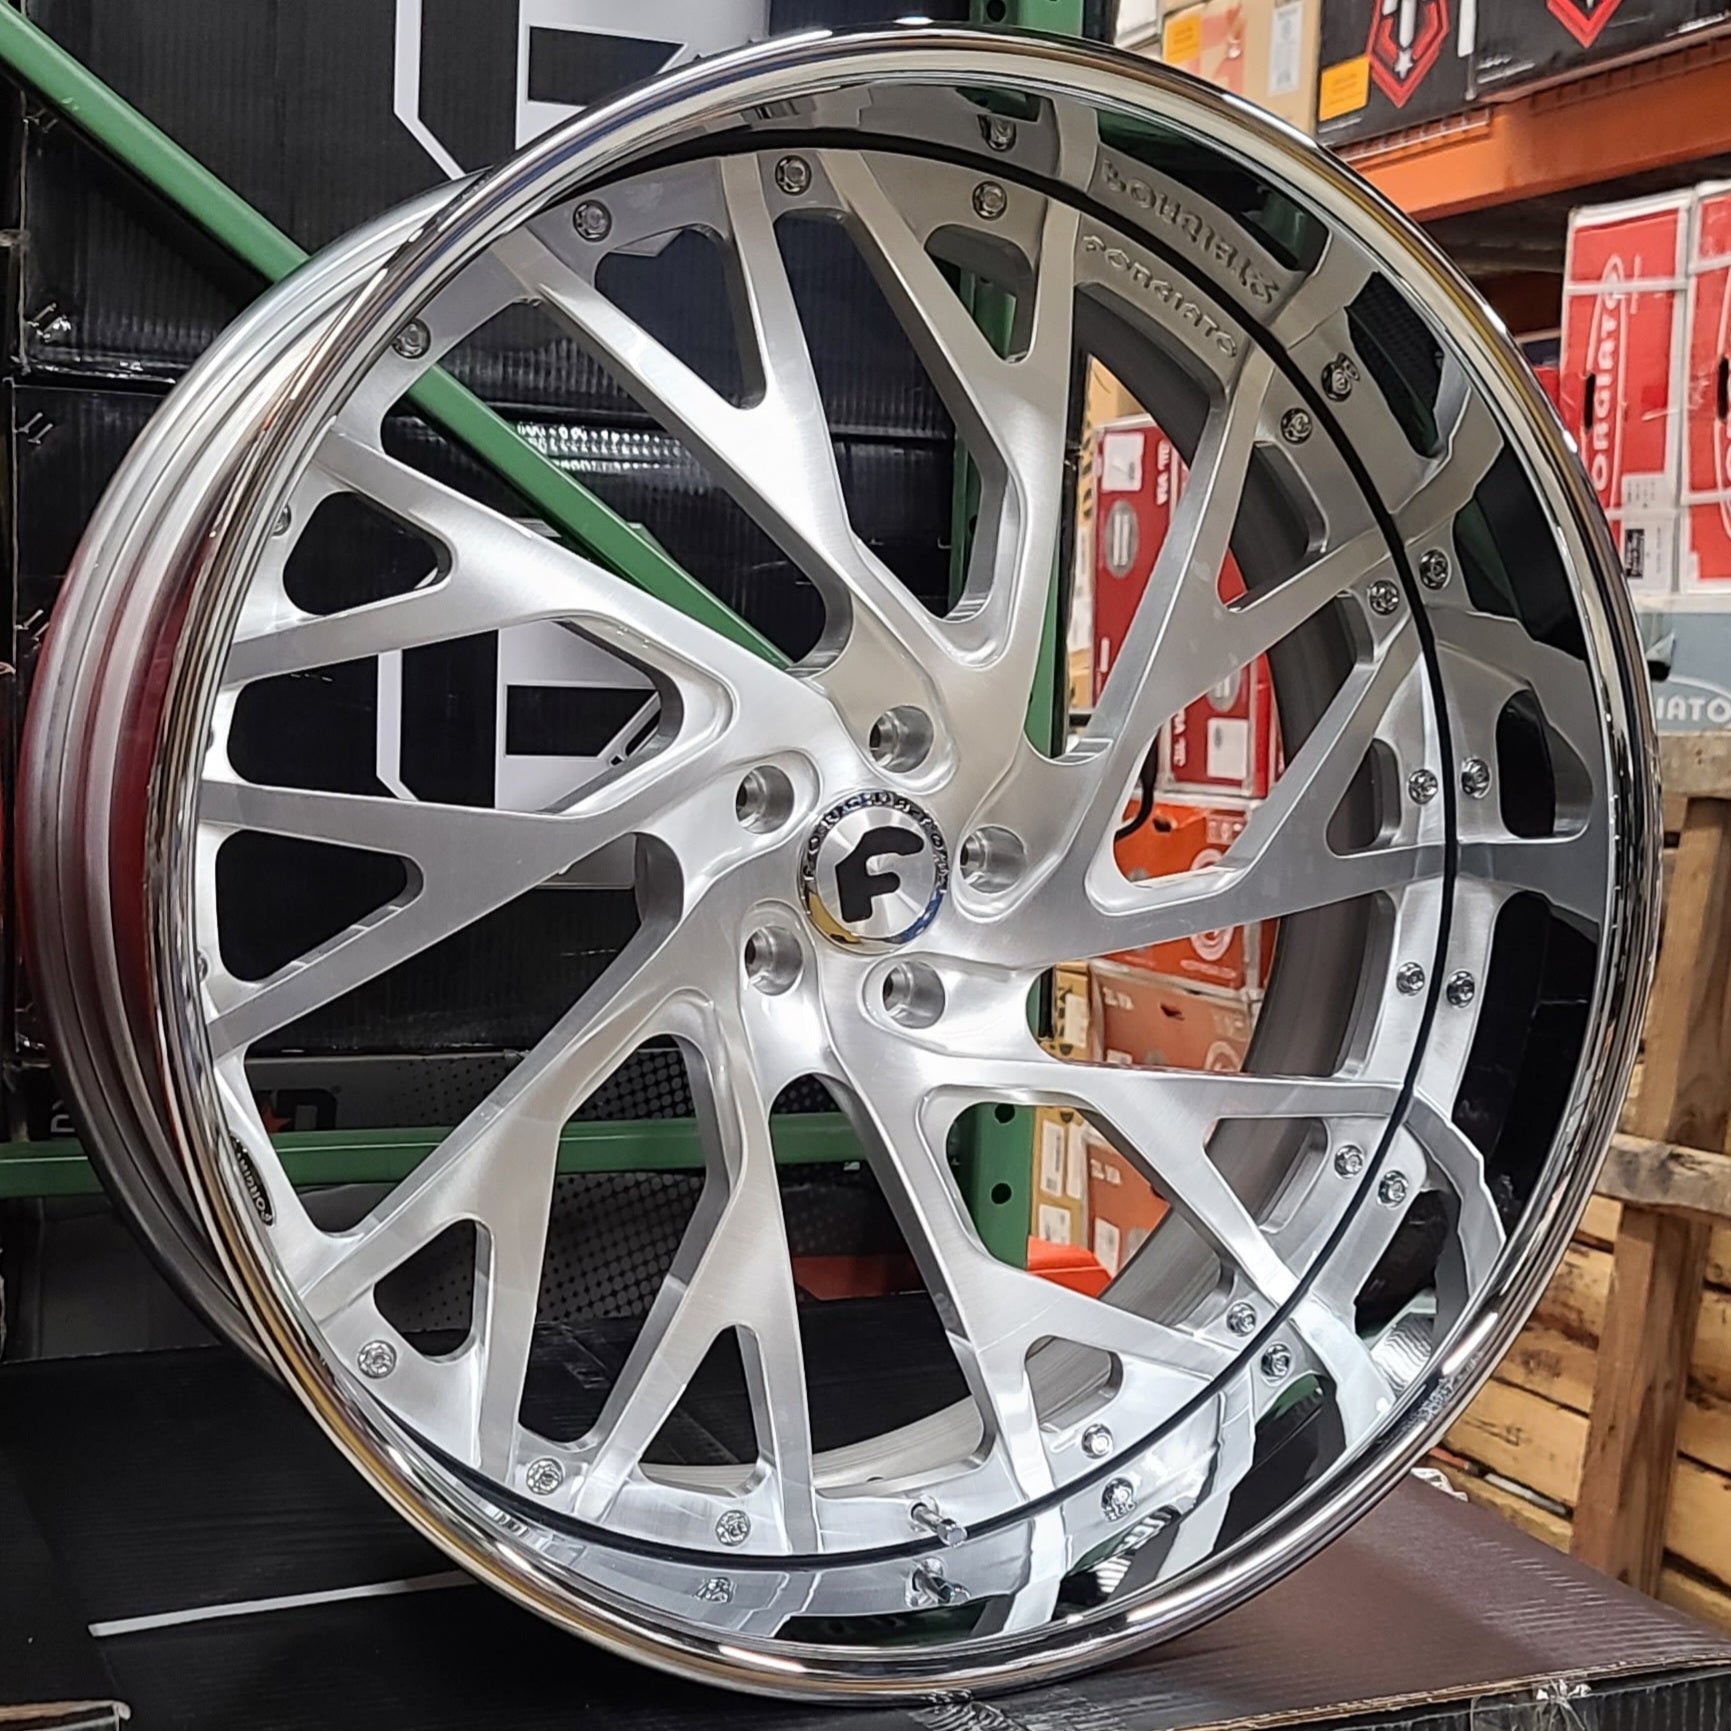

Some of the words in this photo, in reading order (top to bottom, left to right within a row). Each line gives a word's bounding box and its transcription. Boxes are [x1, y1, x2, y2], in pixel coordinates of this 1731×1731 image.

[1083, 234, 1237, 357] FORGIATO
[1591, 270, 1619, 491] ORGIATO
[1655, 694, 1731, 723] IATO
[835, 825, 924, 923] F
